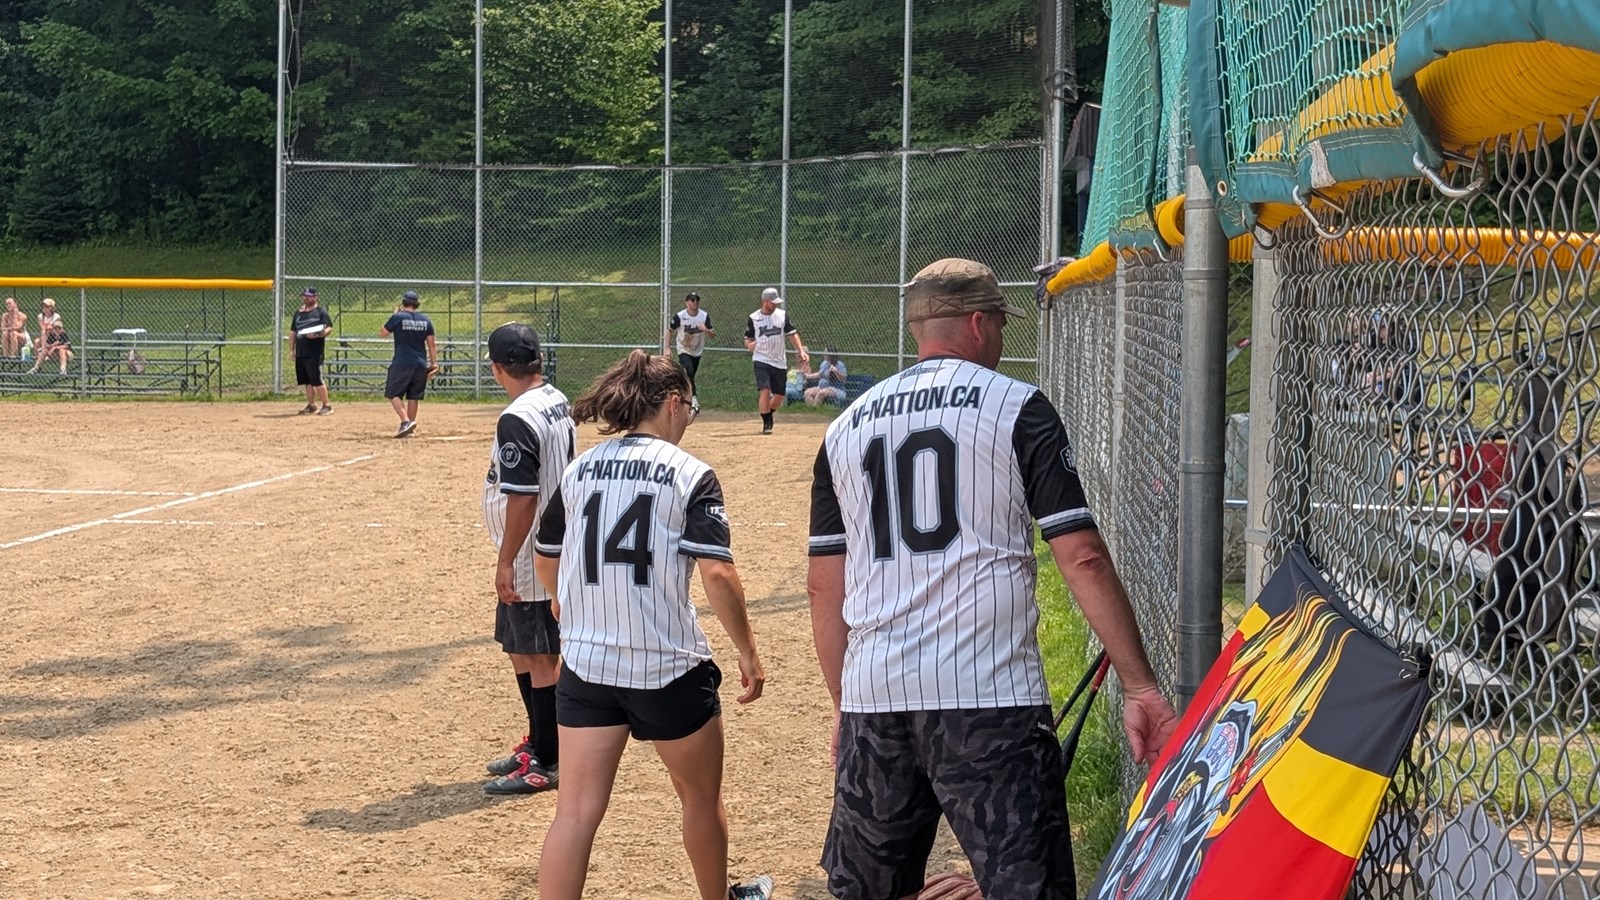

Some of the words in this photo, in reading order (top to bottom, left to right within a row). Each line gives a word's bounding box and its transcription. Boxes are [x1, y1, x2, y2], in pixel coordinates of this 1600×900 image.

[851, 385, 982, 430] V-NATION.CA
[577, 458, 677, 488] V-NATION.CA
[860, 424, 962, 564] 10
[581, 489, 657, 588] 14
